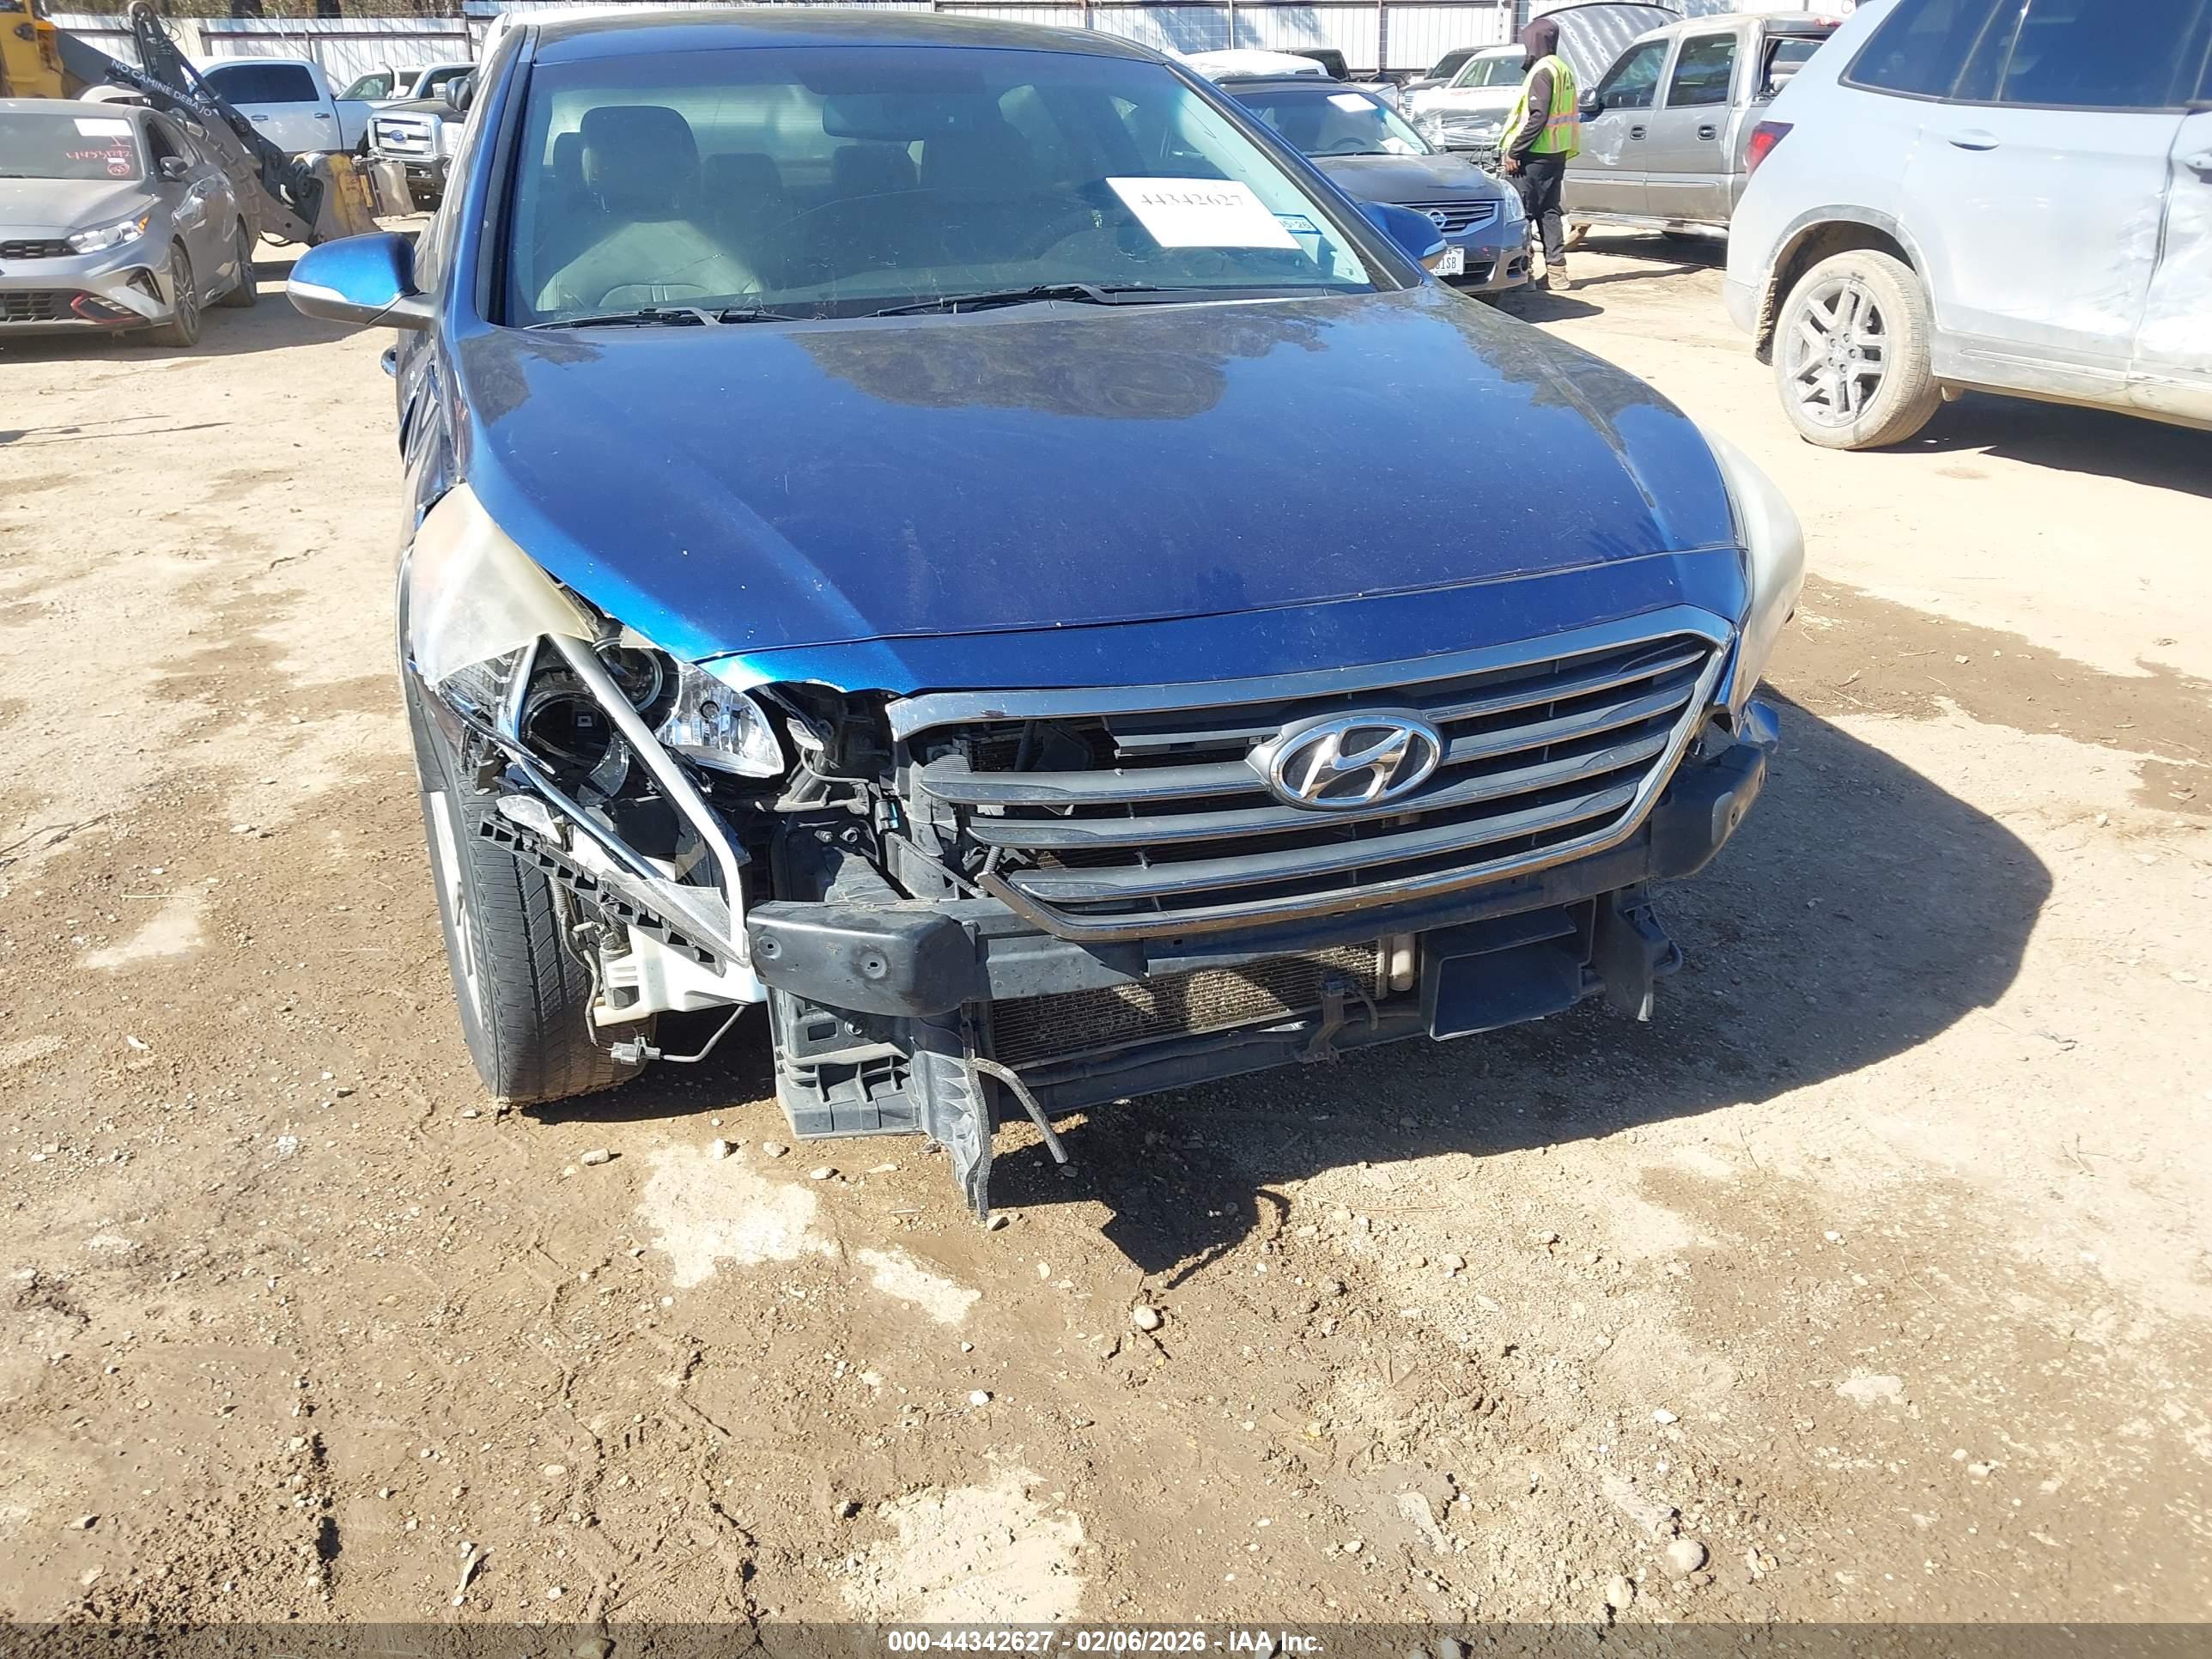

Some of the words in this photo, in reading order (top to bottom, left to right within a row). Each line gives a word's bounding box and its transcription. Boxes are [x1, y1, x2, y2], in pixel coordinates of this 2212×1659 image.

[111, 59, 130, 73] NO
[131, 70, 173, 94] CAMINE
[1140, 193, 1245, 206] 44342627
